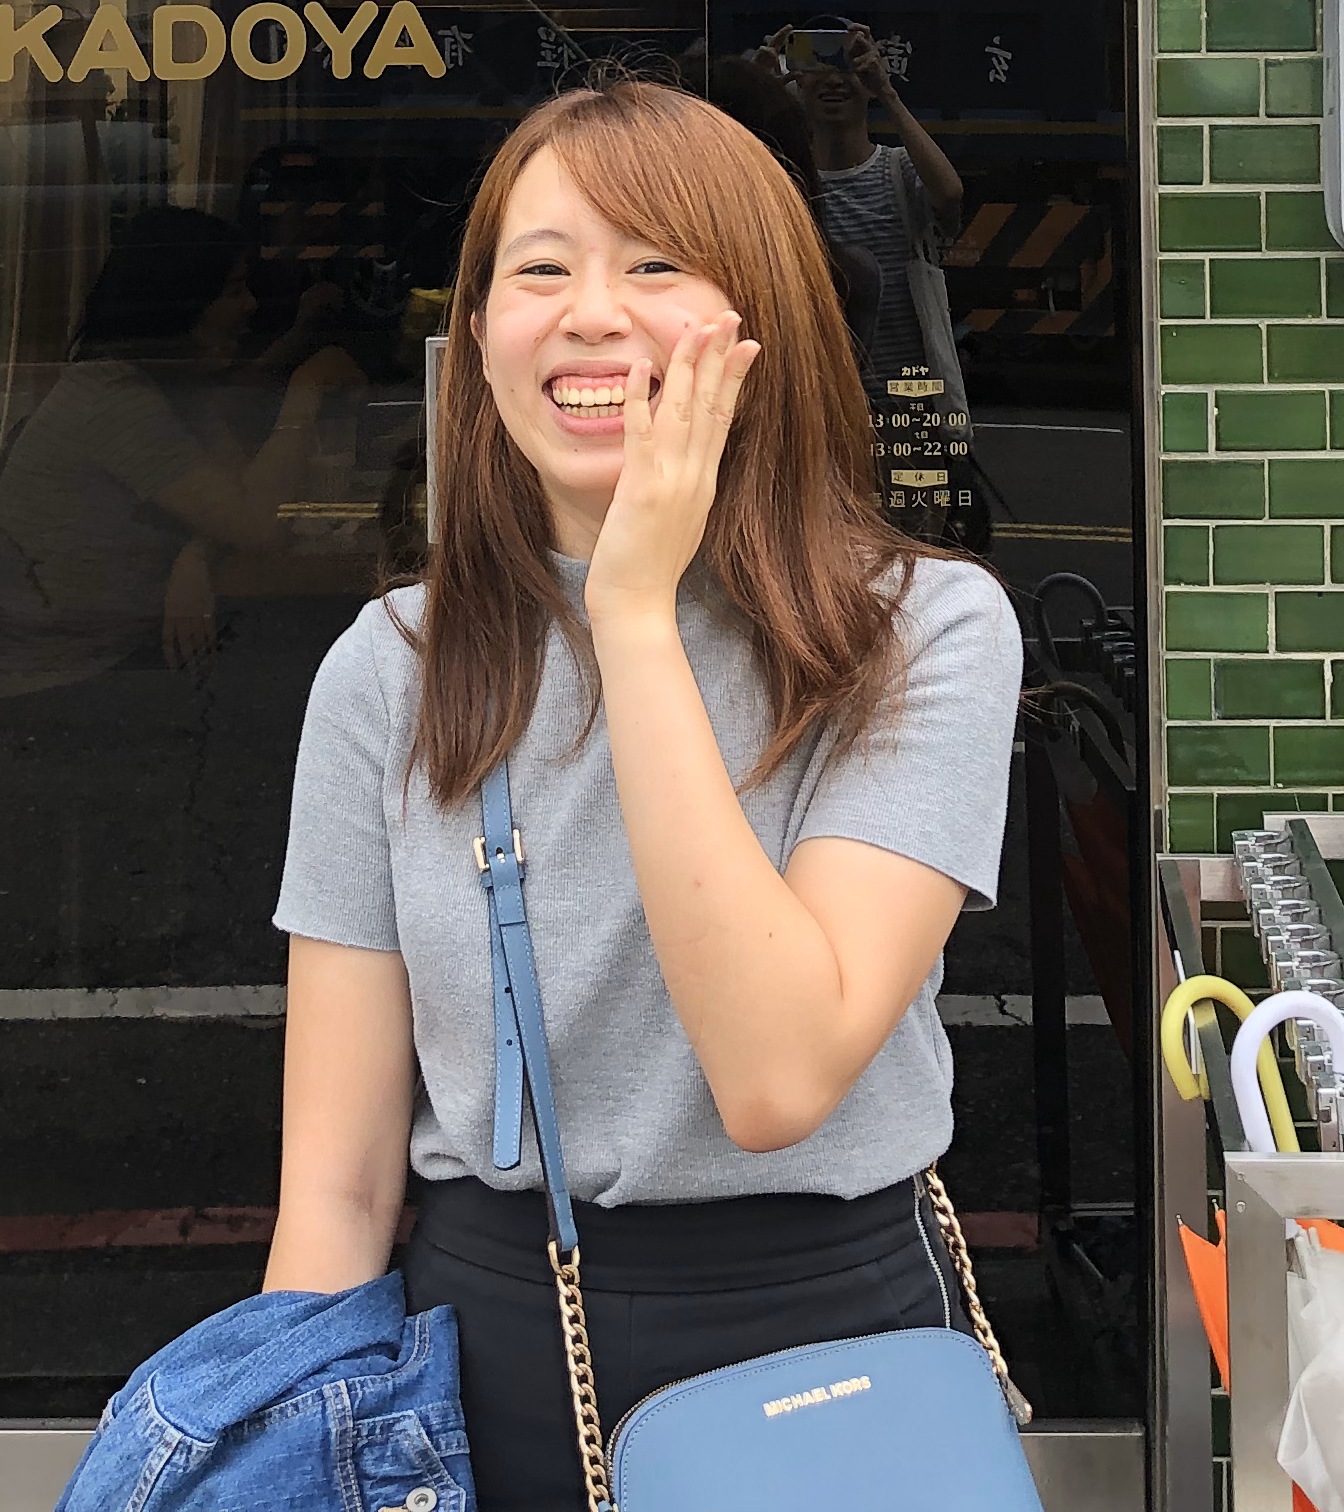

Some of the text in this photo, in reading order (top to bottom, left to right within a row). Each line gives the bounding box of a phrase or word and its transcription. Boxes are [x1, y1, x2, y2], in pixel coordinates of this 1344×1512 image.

[901, 365, 929, 377] カドヤ
[763, 1375, 871, 1417] MICHAEL KORS
